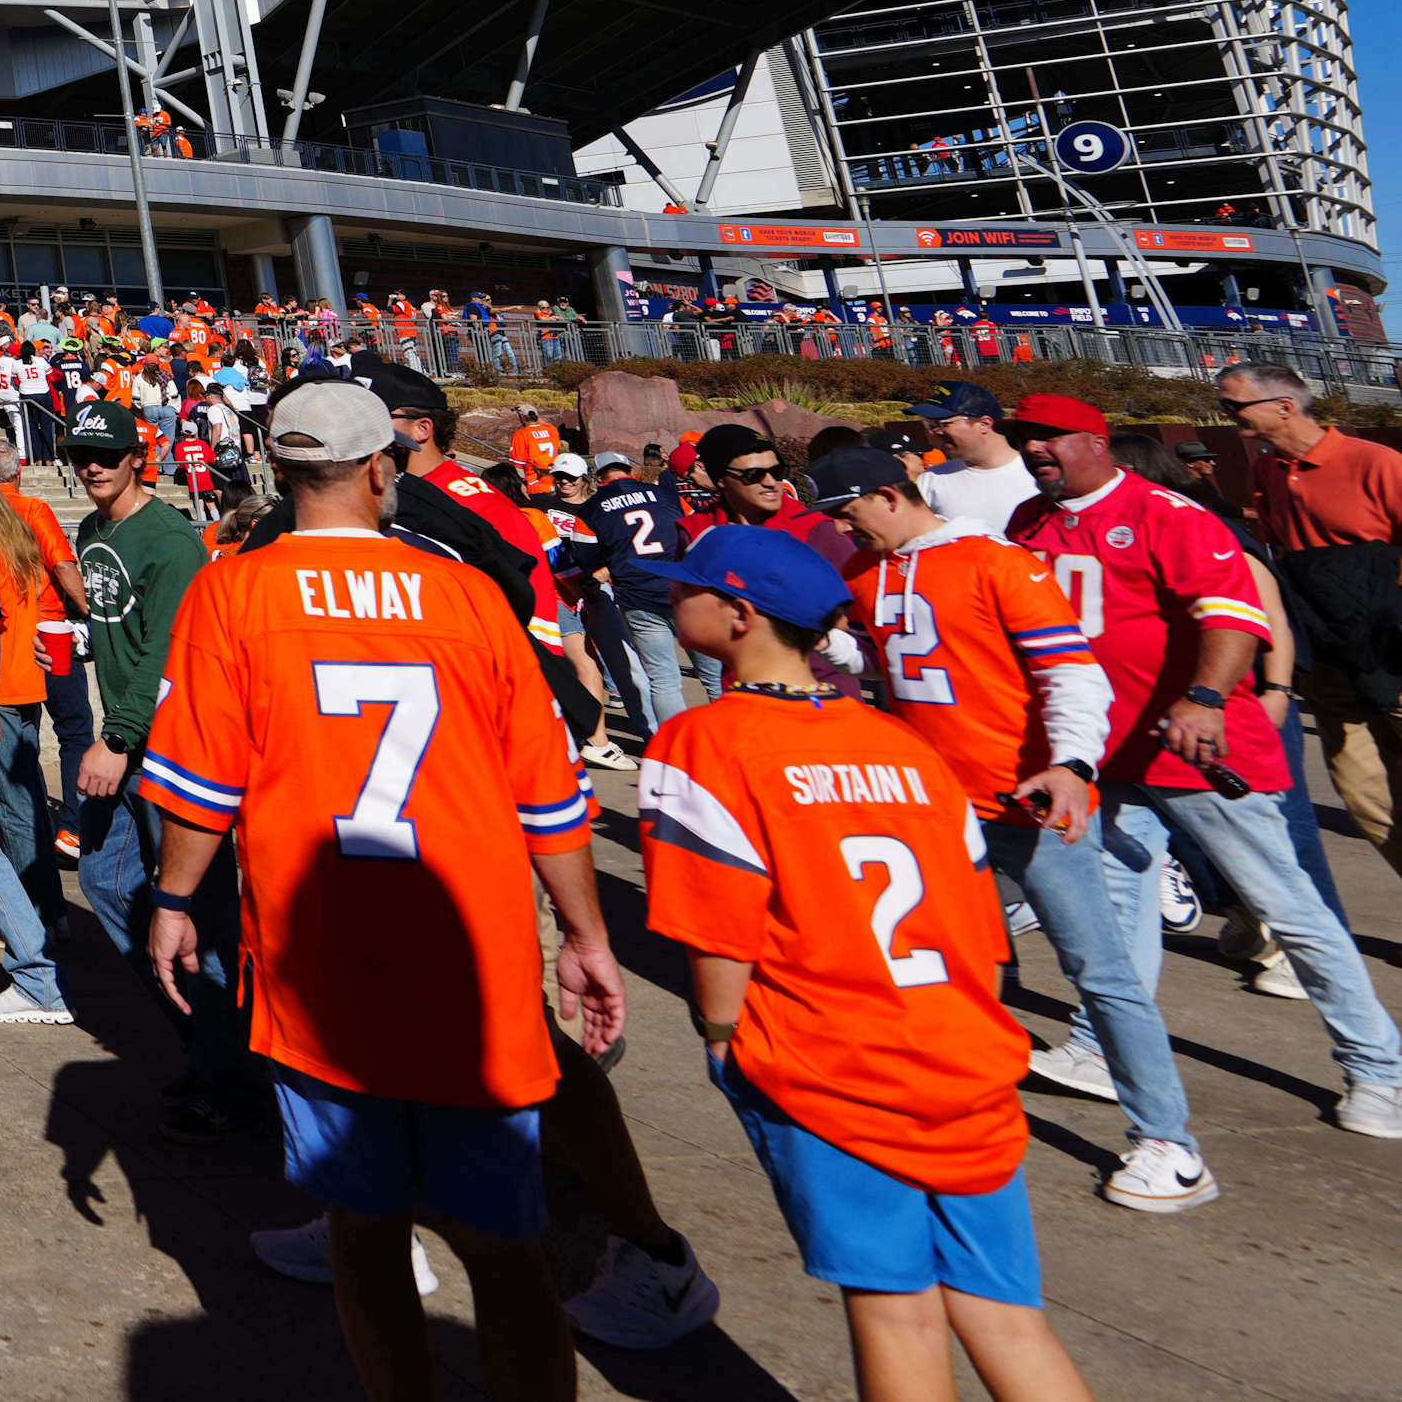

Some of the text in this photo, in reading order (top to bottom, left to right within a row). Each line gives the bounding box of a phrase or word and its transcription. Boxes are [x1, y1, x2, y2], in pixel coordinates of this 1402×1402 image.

[1072, 133, 1105, 162] 9
[946, 232, 981, 244] JOIN
[983, 232, 1017, 244] WIFI
[856, 313, 866, 322] 9
[25, 367, 39, 380] 15
[65, 371, 83, 389] 18
[120, 370, 131, 389] 19
[72, 404, 108, 436] Jets
[537, 442, 555, 459] 7
[185, 453, 207, 473] 15
[447, 475, 495, 498] 87
[601, 491, 645, 512] SURTAIN
[647, 490, 657, 503] II
[623, 509, 665, 556] 2
[296, 569, 425, 622] ELWAY
[880, 591, 956, 706] 2
[312, 660, 442, 861] 7
[784, 764, 932, 806] SURTAIN II
[839, 834, 950, 988] 2
